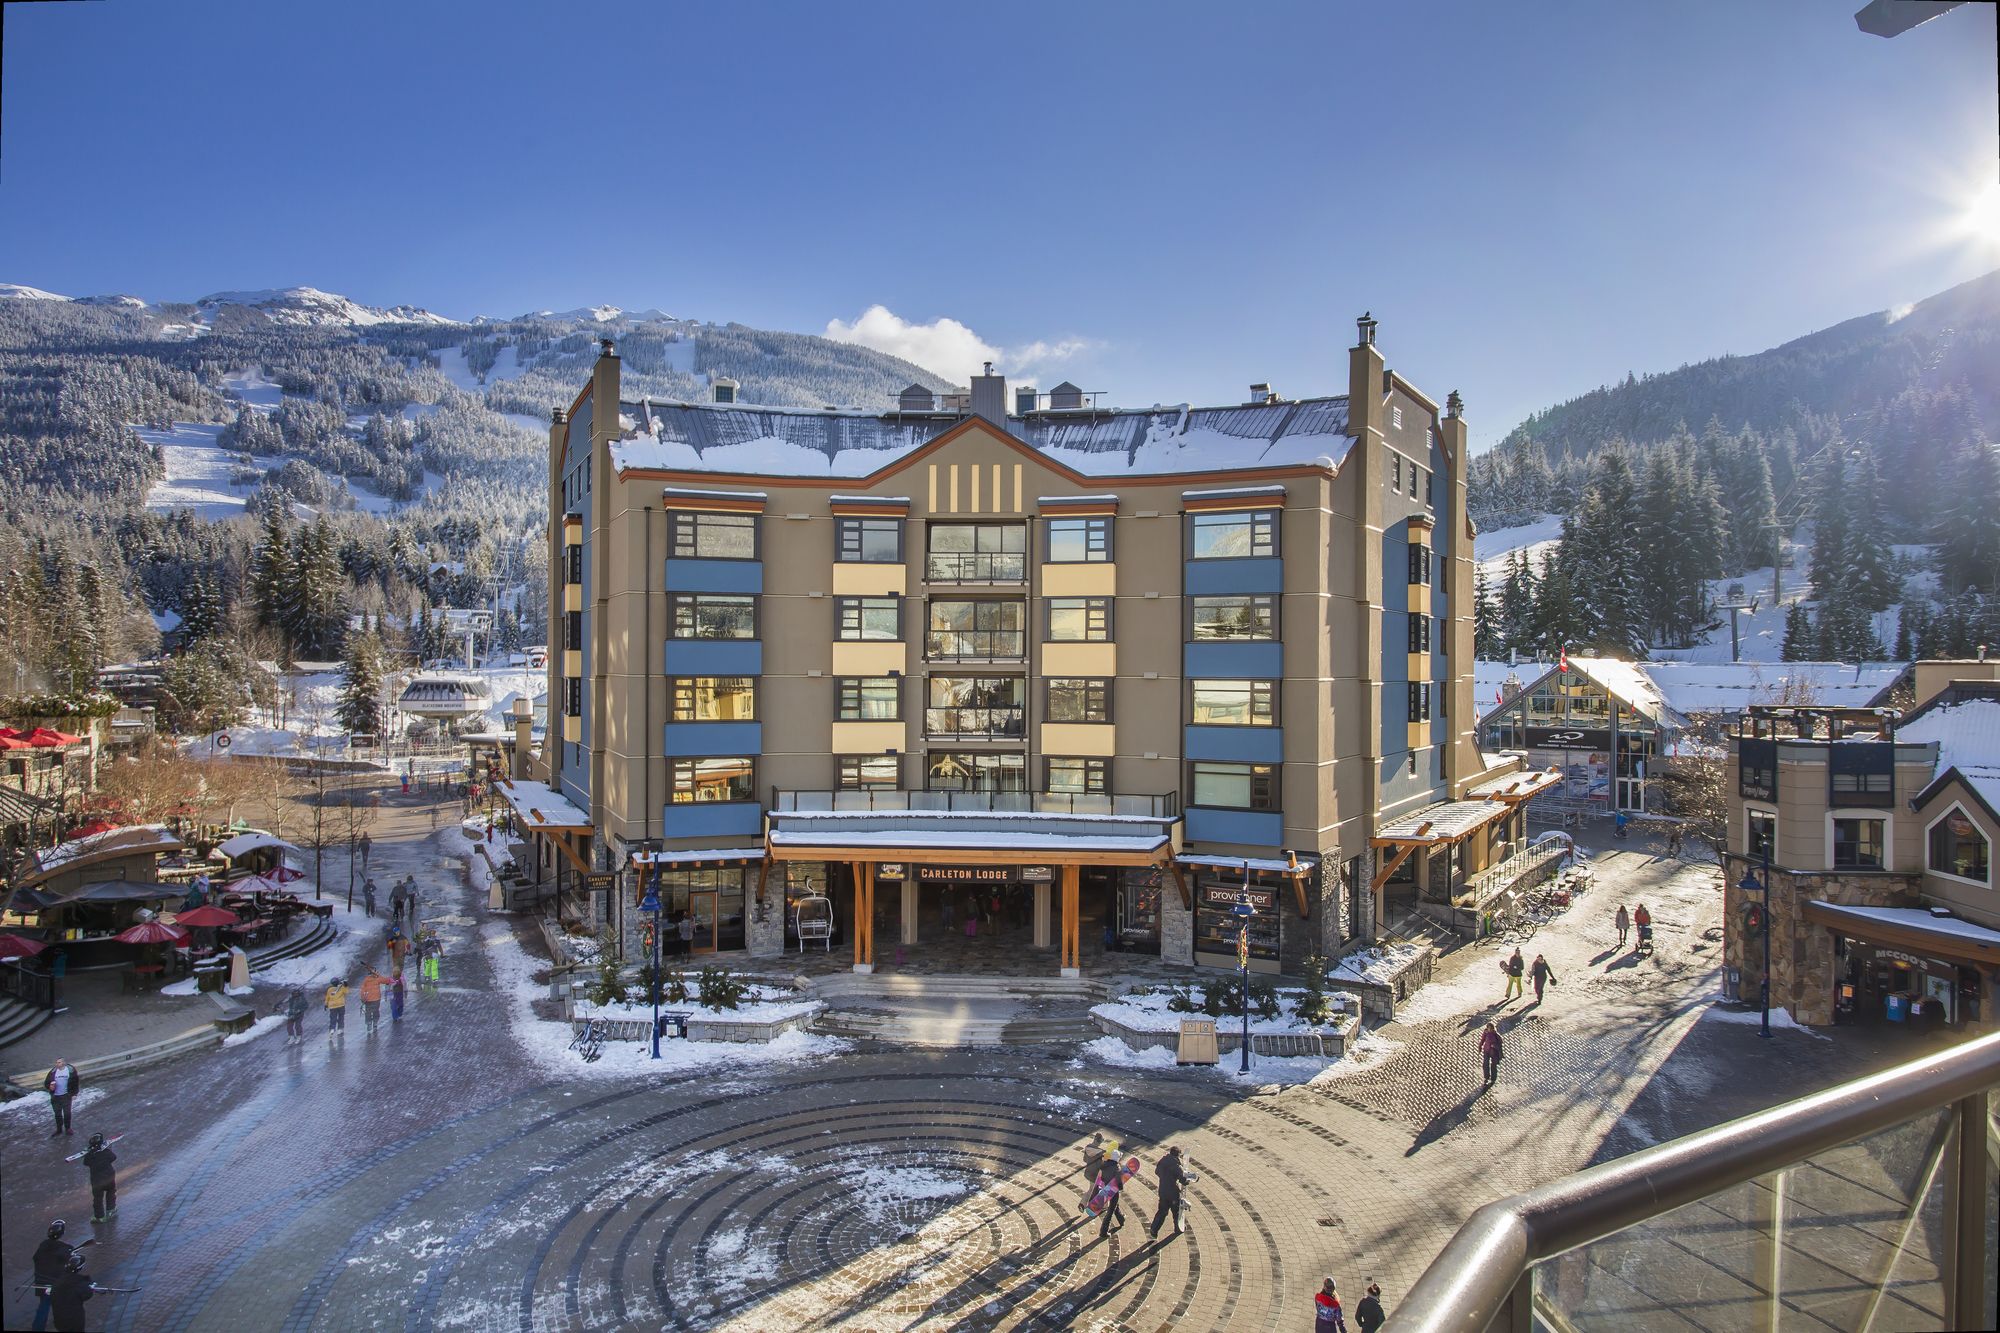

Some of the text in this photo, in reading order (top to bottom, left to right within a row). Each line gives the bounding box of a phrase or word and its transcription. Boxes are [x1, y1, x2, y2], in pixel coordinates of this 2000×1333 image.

[921, 868, 1008, 880] CARLETON LODGE
[1210, 890, 1267, 904] provisoner
